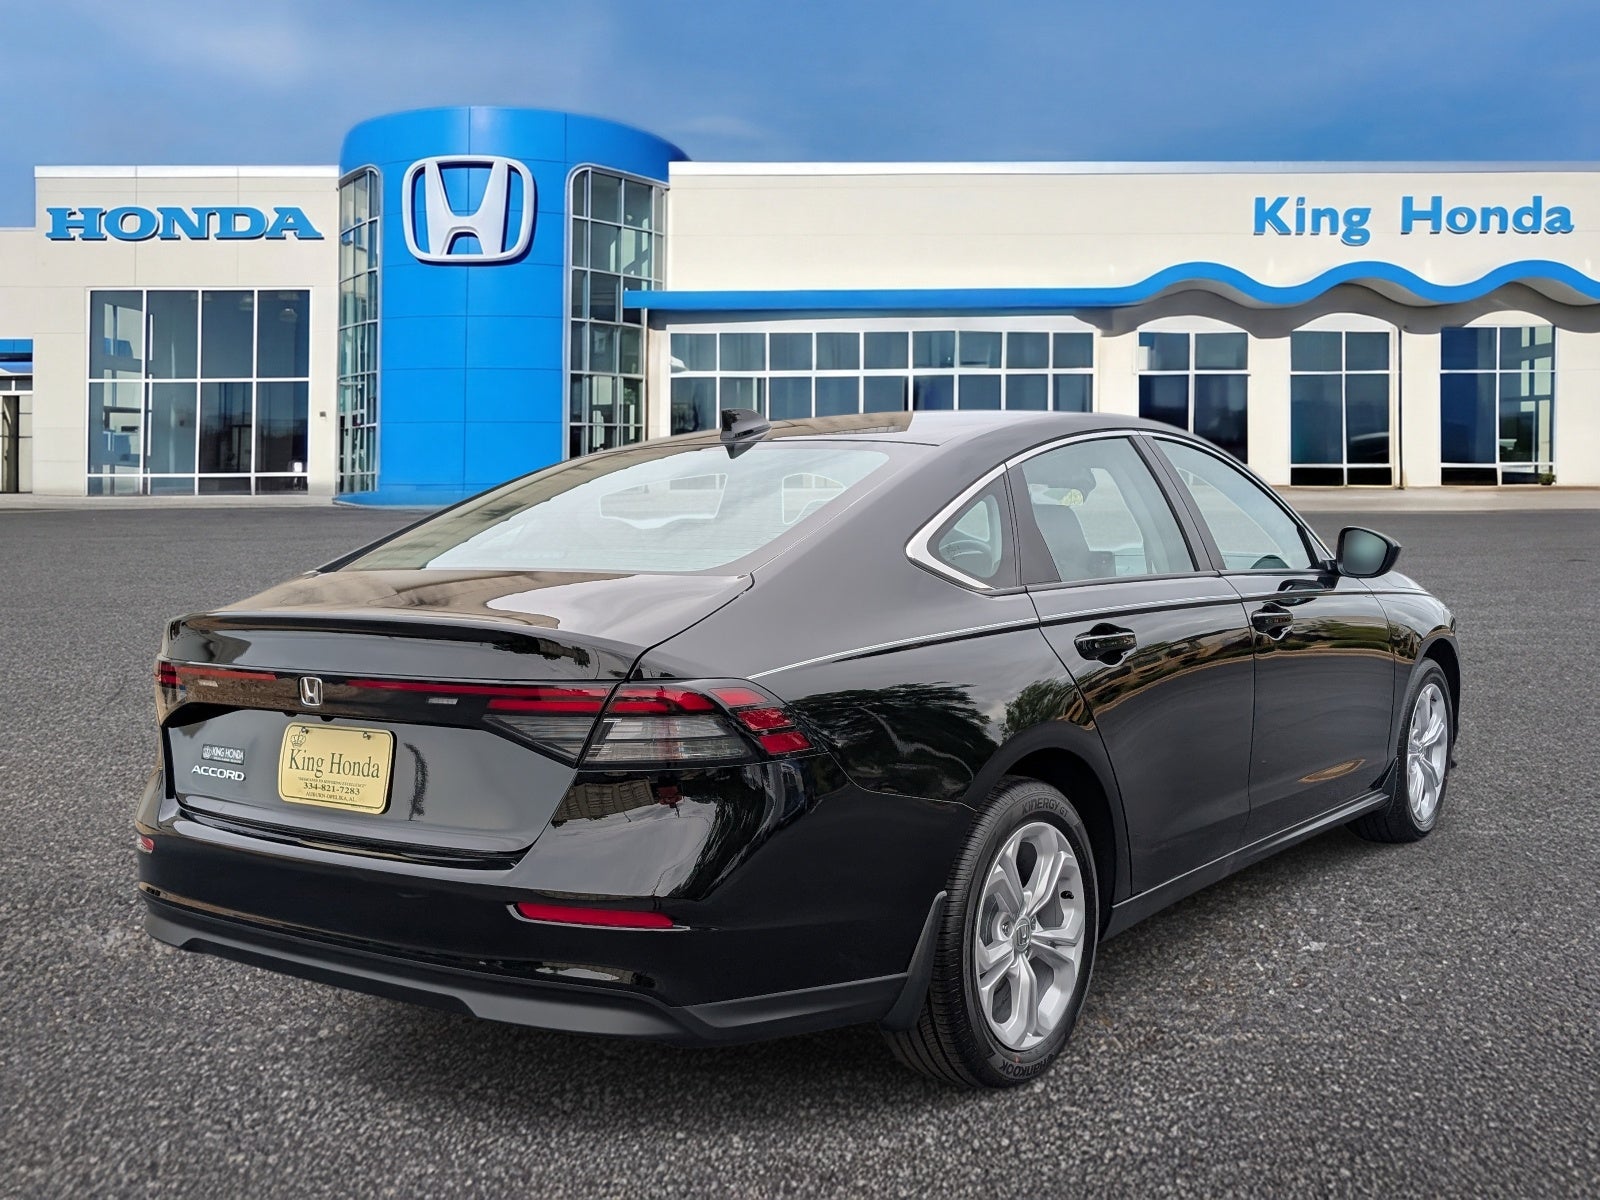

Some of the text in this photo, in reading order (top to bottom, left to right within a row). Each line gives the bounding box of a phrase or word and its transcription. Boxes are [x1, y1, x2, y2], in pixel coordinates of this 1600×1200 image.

[46, 206, 324, 241] HONDA
[1253, 195, 1575, 247] King Honda
[191, 764, 245, 781] ACCORD
[288, 748, 380, 779] King Honda
[303, 781, 360, 796] 334-821-7283
